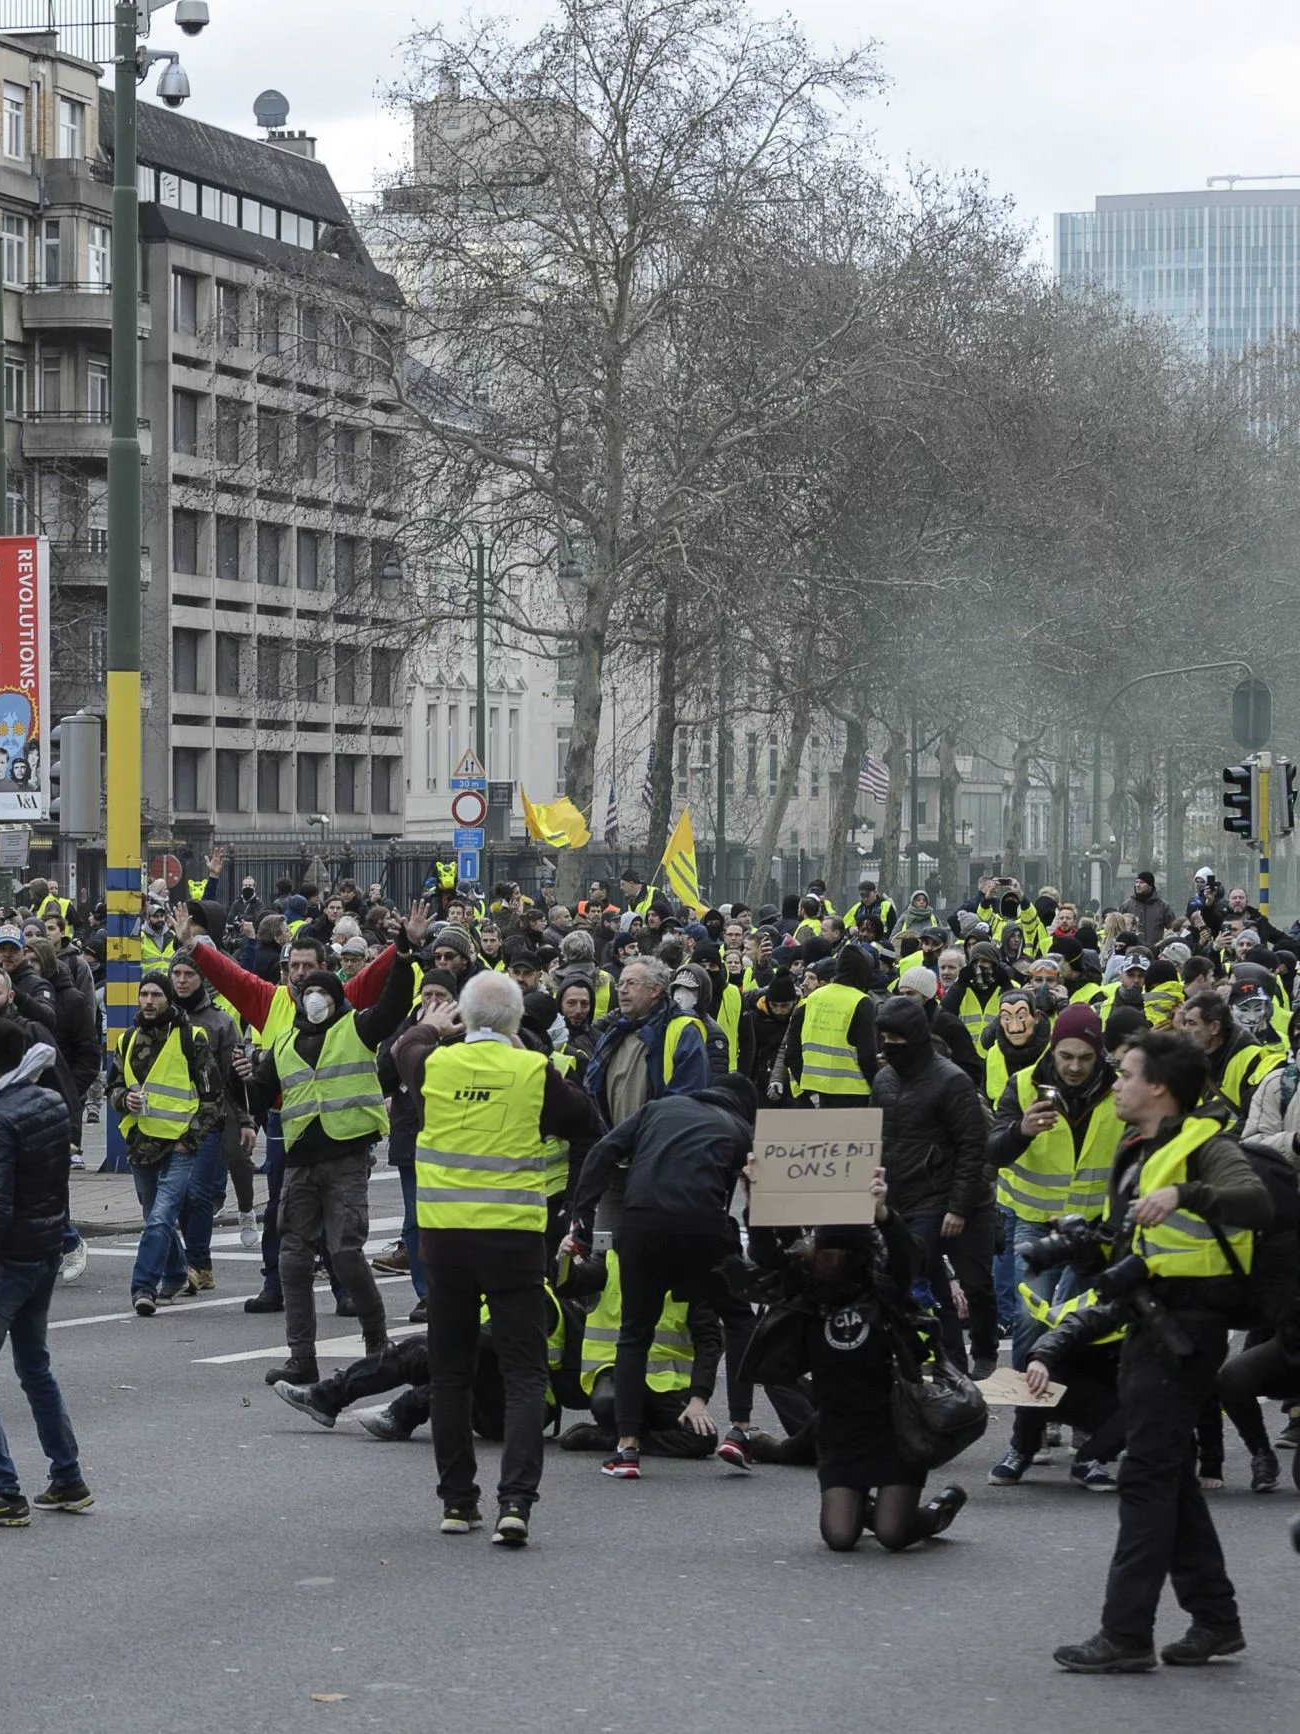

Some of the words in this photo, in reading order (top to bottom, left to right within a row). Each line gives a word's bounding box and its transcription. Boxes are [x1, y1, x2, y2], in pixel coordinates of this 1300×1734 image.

[18, 549, 35, 690] REVOLUTIONS
[459, 780, 470, 788] 30
[16, 794, 38, 809] V&A
[834, 1311, 863, 1328] CIA
